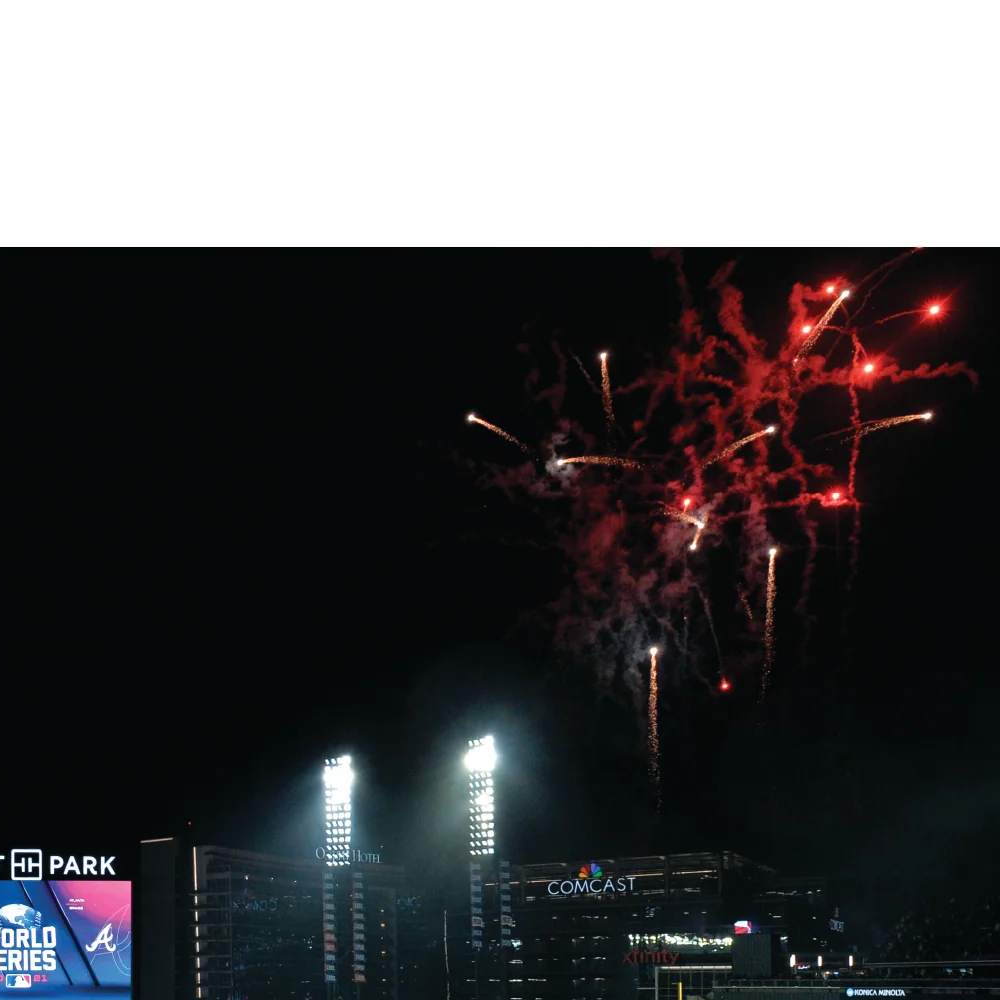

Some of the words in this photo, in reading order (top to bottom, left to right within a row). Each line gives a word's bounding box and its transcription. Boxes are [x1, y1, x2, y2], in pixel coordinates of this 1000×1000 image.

[50, 855, 116, 876] PARK
[547, 877, 636, 895] COMCAST
[623, 948, 680, 966] xfinity
[878, 989, 906, 997] MINOLTA
